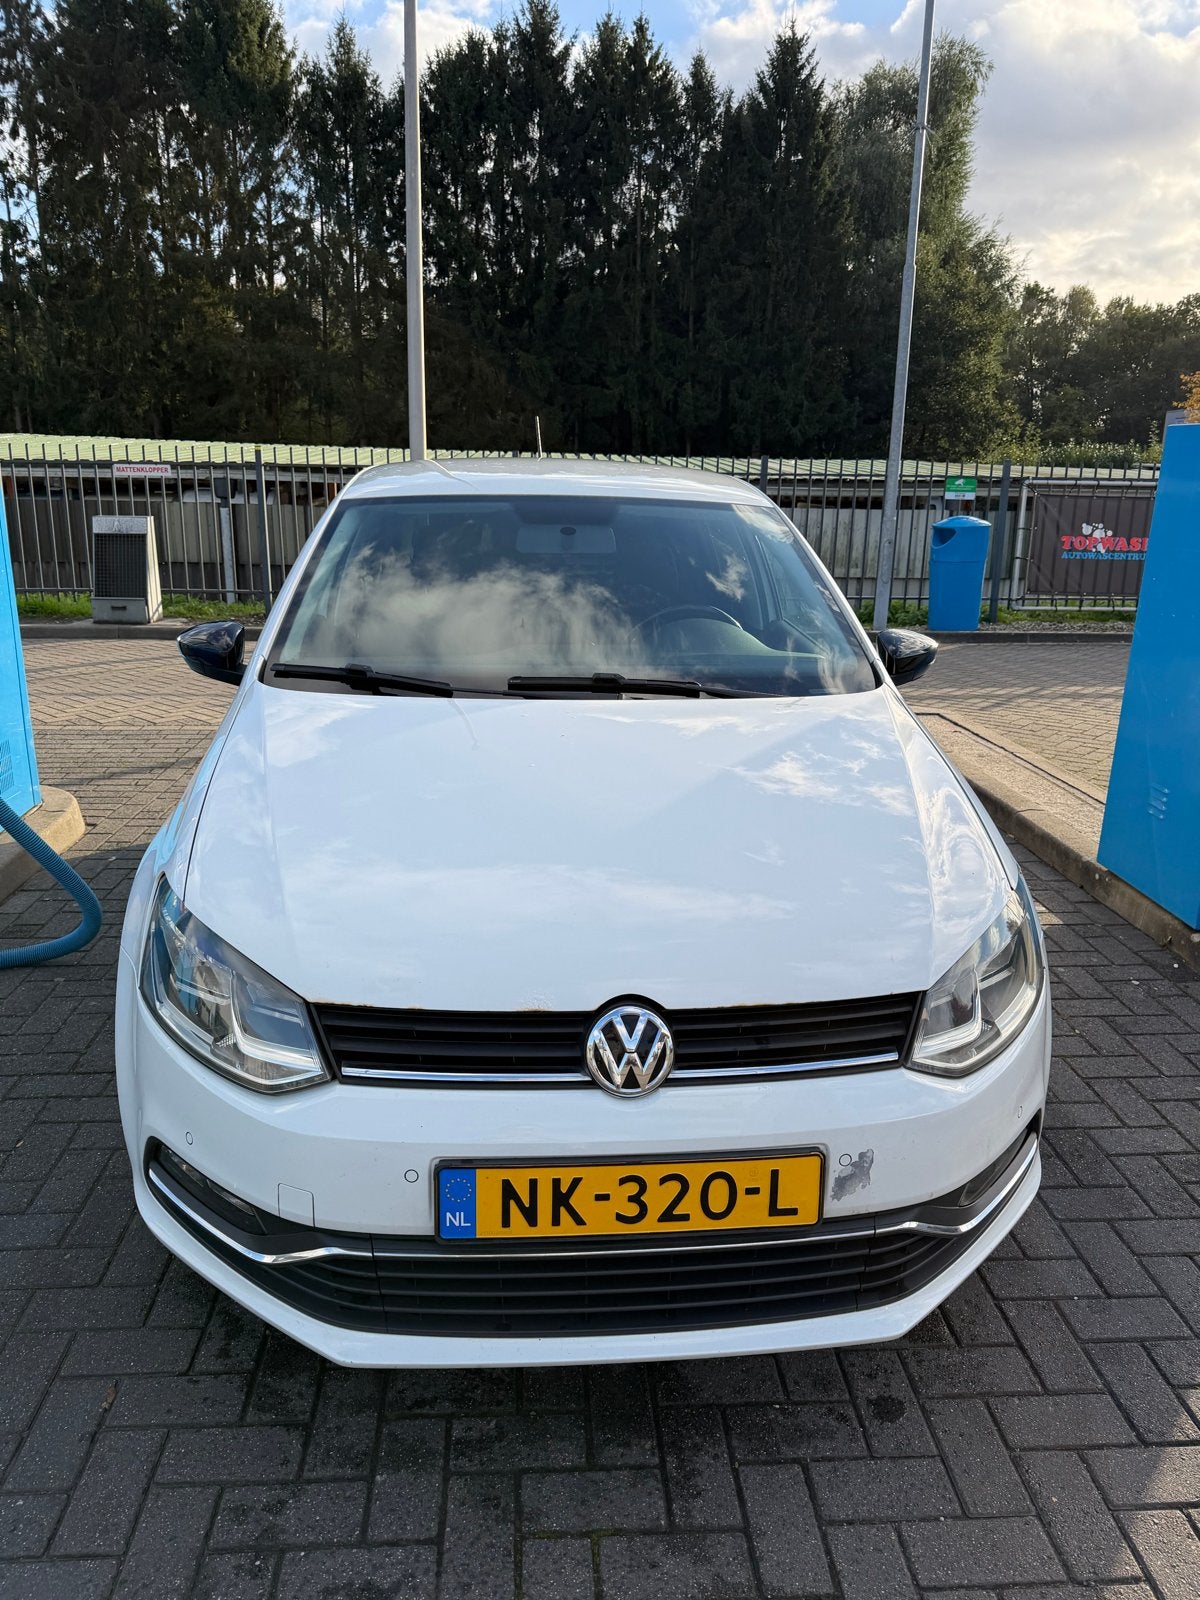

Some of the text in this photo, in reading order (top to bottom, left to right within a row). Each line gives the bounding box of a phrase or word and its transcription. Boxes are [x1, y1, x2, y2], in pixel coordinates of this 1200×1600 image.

[589, 1010, 671, 1093] VW
[445, 1211, 472, 1227] NL
[500, 1168, 799, 1229] NK-320-L
